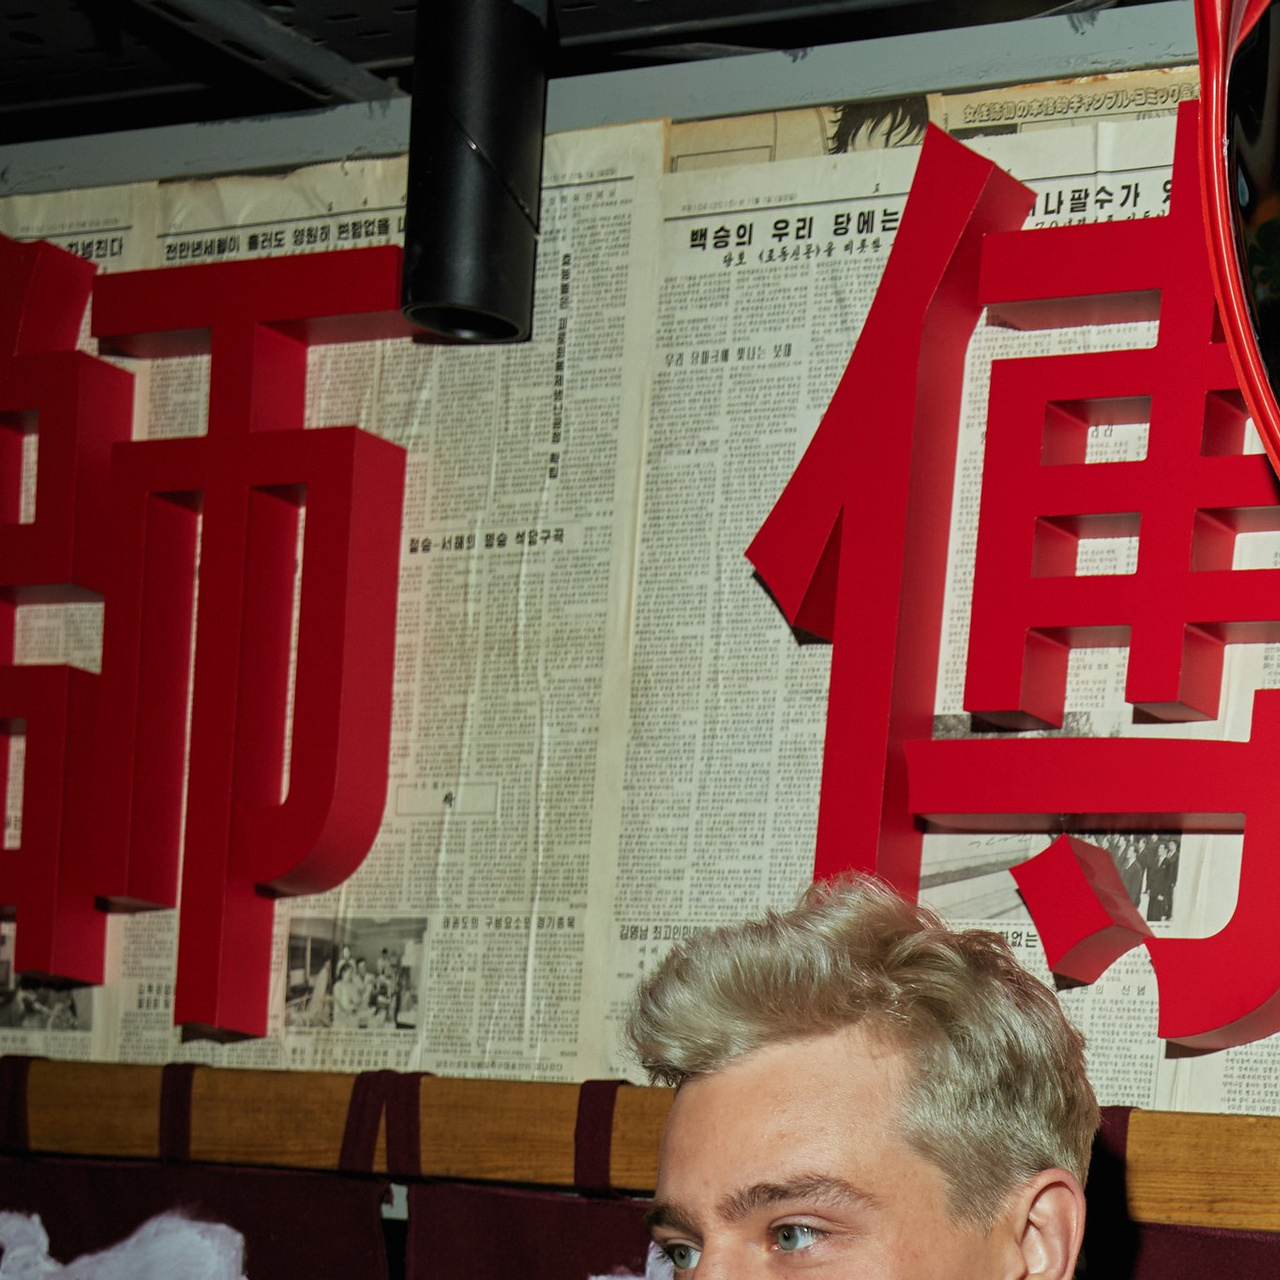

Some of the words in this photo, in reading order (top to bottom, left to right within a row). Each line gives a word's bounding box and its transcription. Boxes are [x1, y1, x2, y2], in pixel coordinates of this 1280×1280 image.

[690, 221, 754, 251] 백승의
[771, 216, 814, 243] 우리
[832, 208, 900, 236] 당에는
[1031, 181, 1141, 217] 나팔수가
